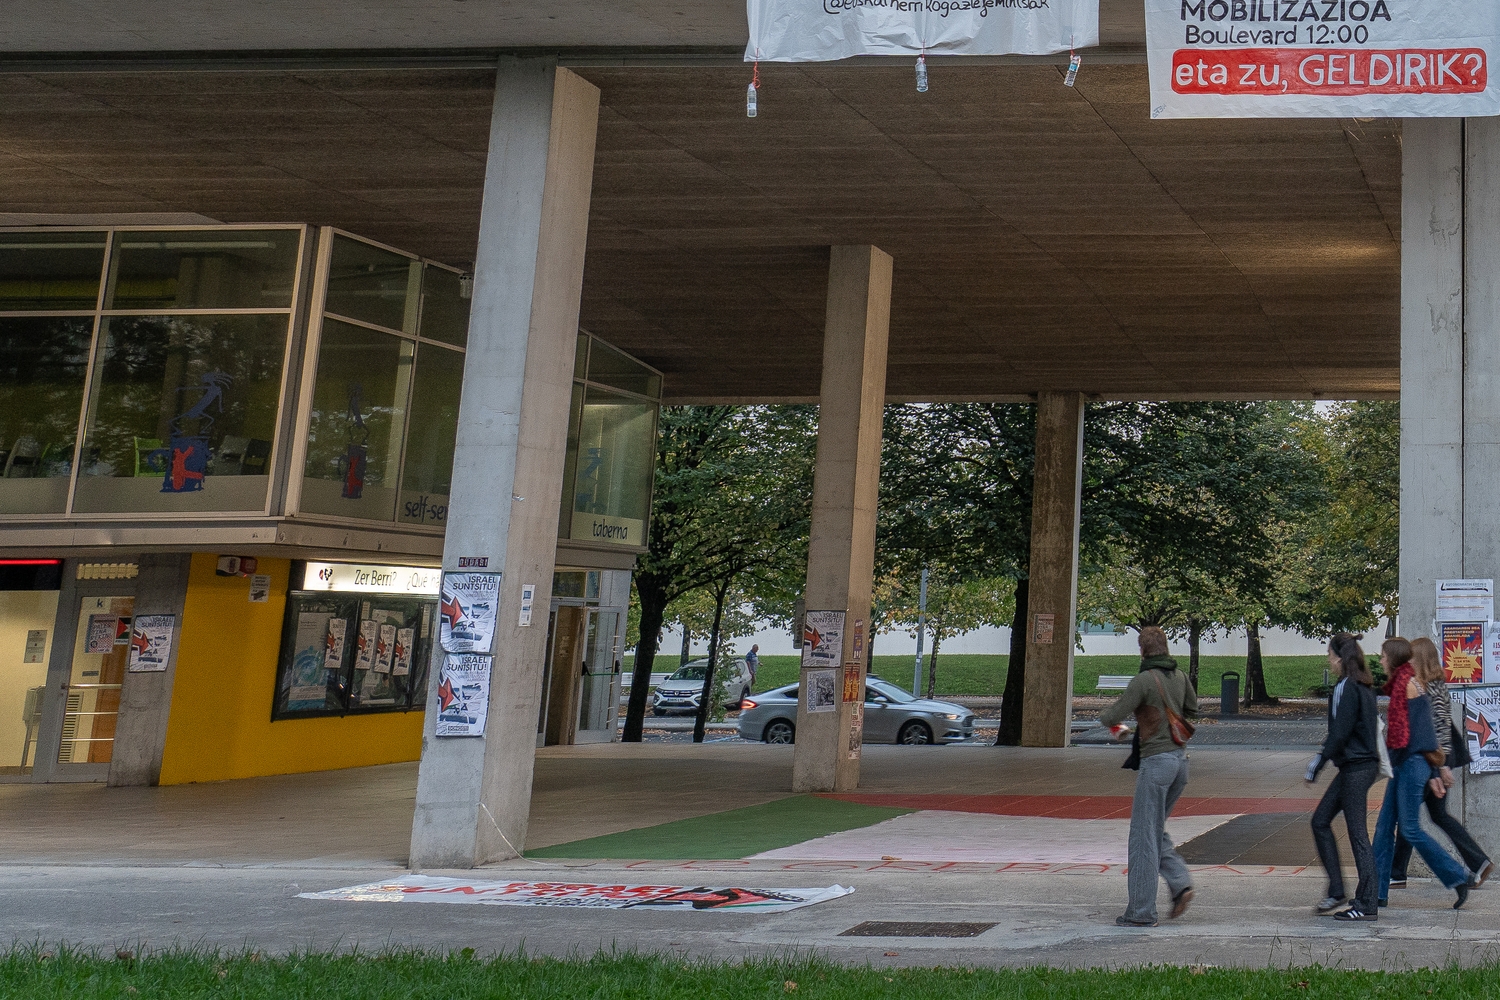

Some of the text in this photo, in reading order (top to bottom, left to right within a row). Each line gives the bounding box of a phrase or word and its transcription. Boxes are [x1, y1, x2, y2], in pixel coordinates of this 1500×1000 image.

[1180, 0, 1392, 23] MOBILIZAZIOA
[1185, 24, 1369, 46] Boulevard 12:00
[1175, 52, 1484, 93] eta zu, GELDIRIK?
[593, 520, 628, 541] taberna
[354, 569, 428, 590] Zer Berri? ¿Qué
[468, 576, 496, 584] ISRAEL
[446, 663, 487, 671] SUNTSITU!
